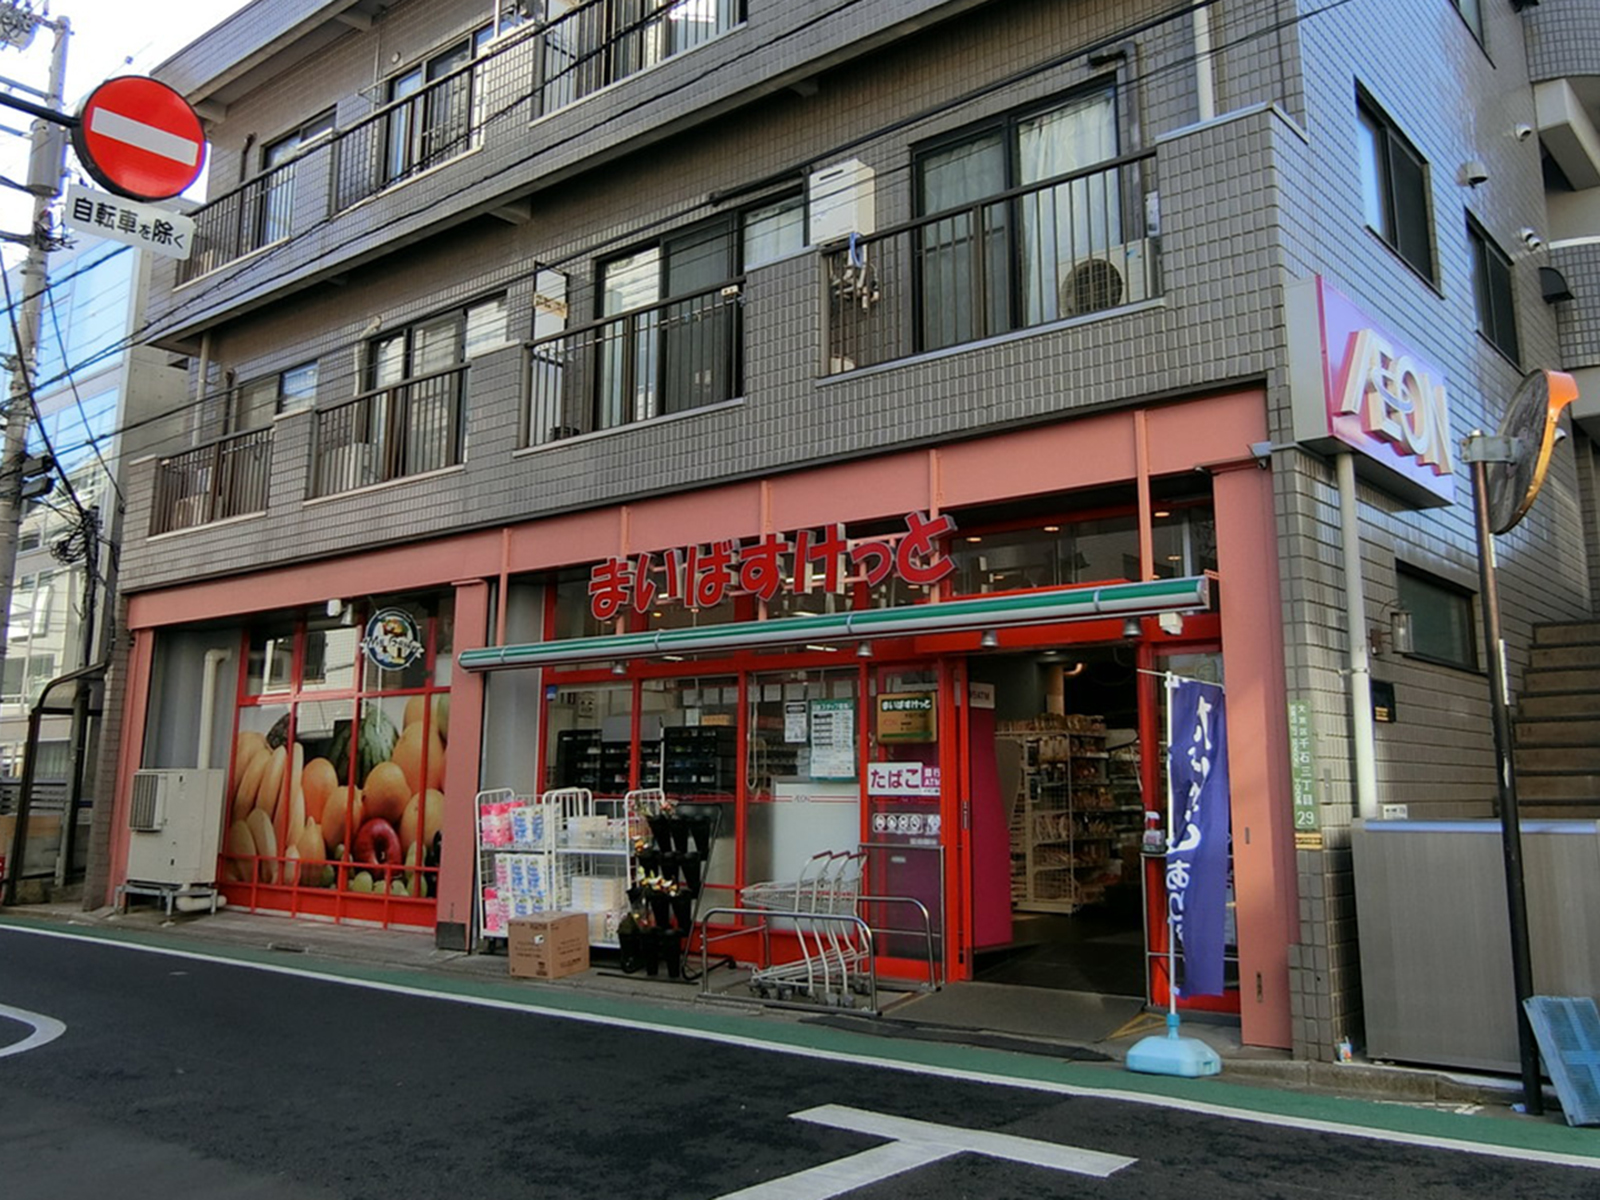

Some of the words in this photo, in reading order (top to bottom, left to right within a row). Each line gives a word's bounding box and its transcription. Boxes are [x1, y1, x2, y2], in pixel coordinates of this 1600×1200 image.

[73, 198, 186, 250] 自転車を除く
[1333, 328, 1453, 476] AEON
[588, 510, 958, 621] まいばすけっと
[870, 768, 921, 789] たばこ
[1297, 811, 1315, 826] 29
